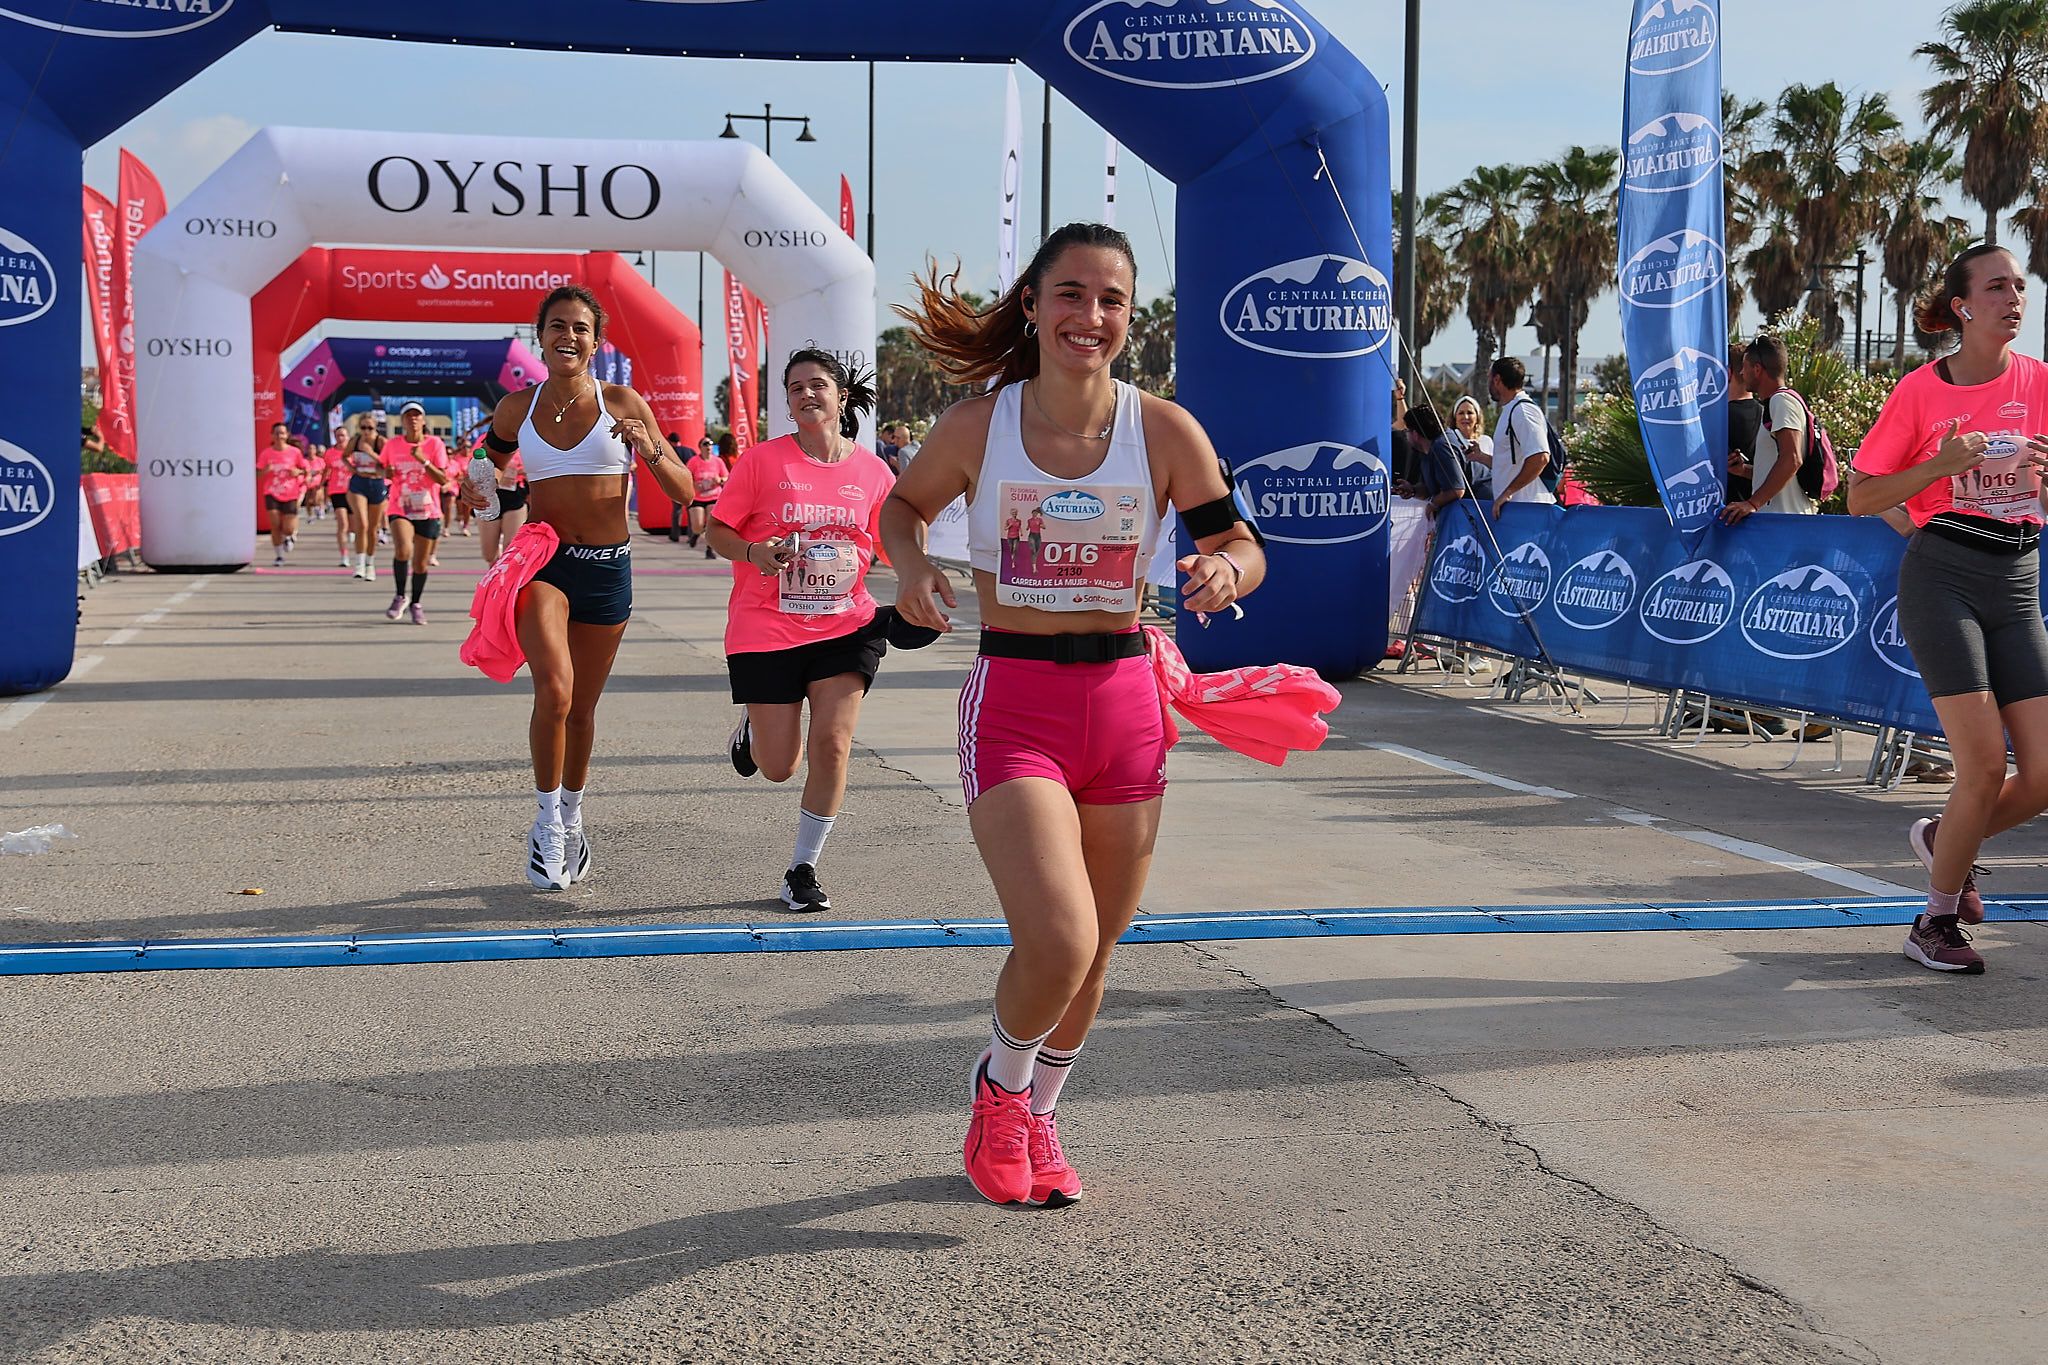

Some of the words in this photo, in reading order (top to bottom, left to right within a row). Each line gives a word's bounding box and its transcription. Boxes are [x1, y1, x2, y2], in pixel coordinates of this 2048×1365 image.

[1125, 13, 1208, 28] CENTRAL
[1216, 11, 1288, 24] LECHERA
[1086, 20, 1304, 61] ASTURIANA
[368, 156, 661, 221] OYSHO
[184, 217, 278, 239] OYSHO
[744, 230, 827, 247] OYSHO
[342, 265, 417, 293] Sports
[453, 269, 572, 291] Santander
[1268, 290, 1337, 301] CENTRAL
[1234, 292, 1389, 332] ASTURIANA
[147, 338, 232, 357] OYSHO
[655, 375, 688, 386] Sports
[652, 391, 700, 401] Santander
[149, 459, 234, 477] OYSHO
[778, 481, 813, 492] OYSHO
[1264, 477, 1332, 488] CENTRAL
[1338, 475, 1384, 487] LECHERA
[1983, 472, 2016, 488] 016
[1011, 493, 1039, 502] SUMA
[1046, 501, 1101, 514] ASTURIANA
[782, 502, 857, 529] CARRERA
[565, 546, 614, 560] NIKE
[1043, 543, 1098, 564] 016
[1057, 567, 1083, 577] 2130
[807, 574, 836, 587] 016
[1011, 576, 1042, 586] CARRERA
[1043, 578, 1052, 586] DE
[1054, 578, 1063, 586] LA
[1065, 578, 1088, 586] MUJER
[1012, 592, 1056, 604] OYSHO
[1083, 594, 1123, 605] Santander
[1557, 575, 1626, 612] ASTURIANA
[1770, 593, 1806, 607] CENTRAL
[789, 602, 815, 610] OYSHO
[1644, 585, 1725, 625] ASTURIANA
[1746, 594, 1846, 640] ASTURIANA
